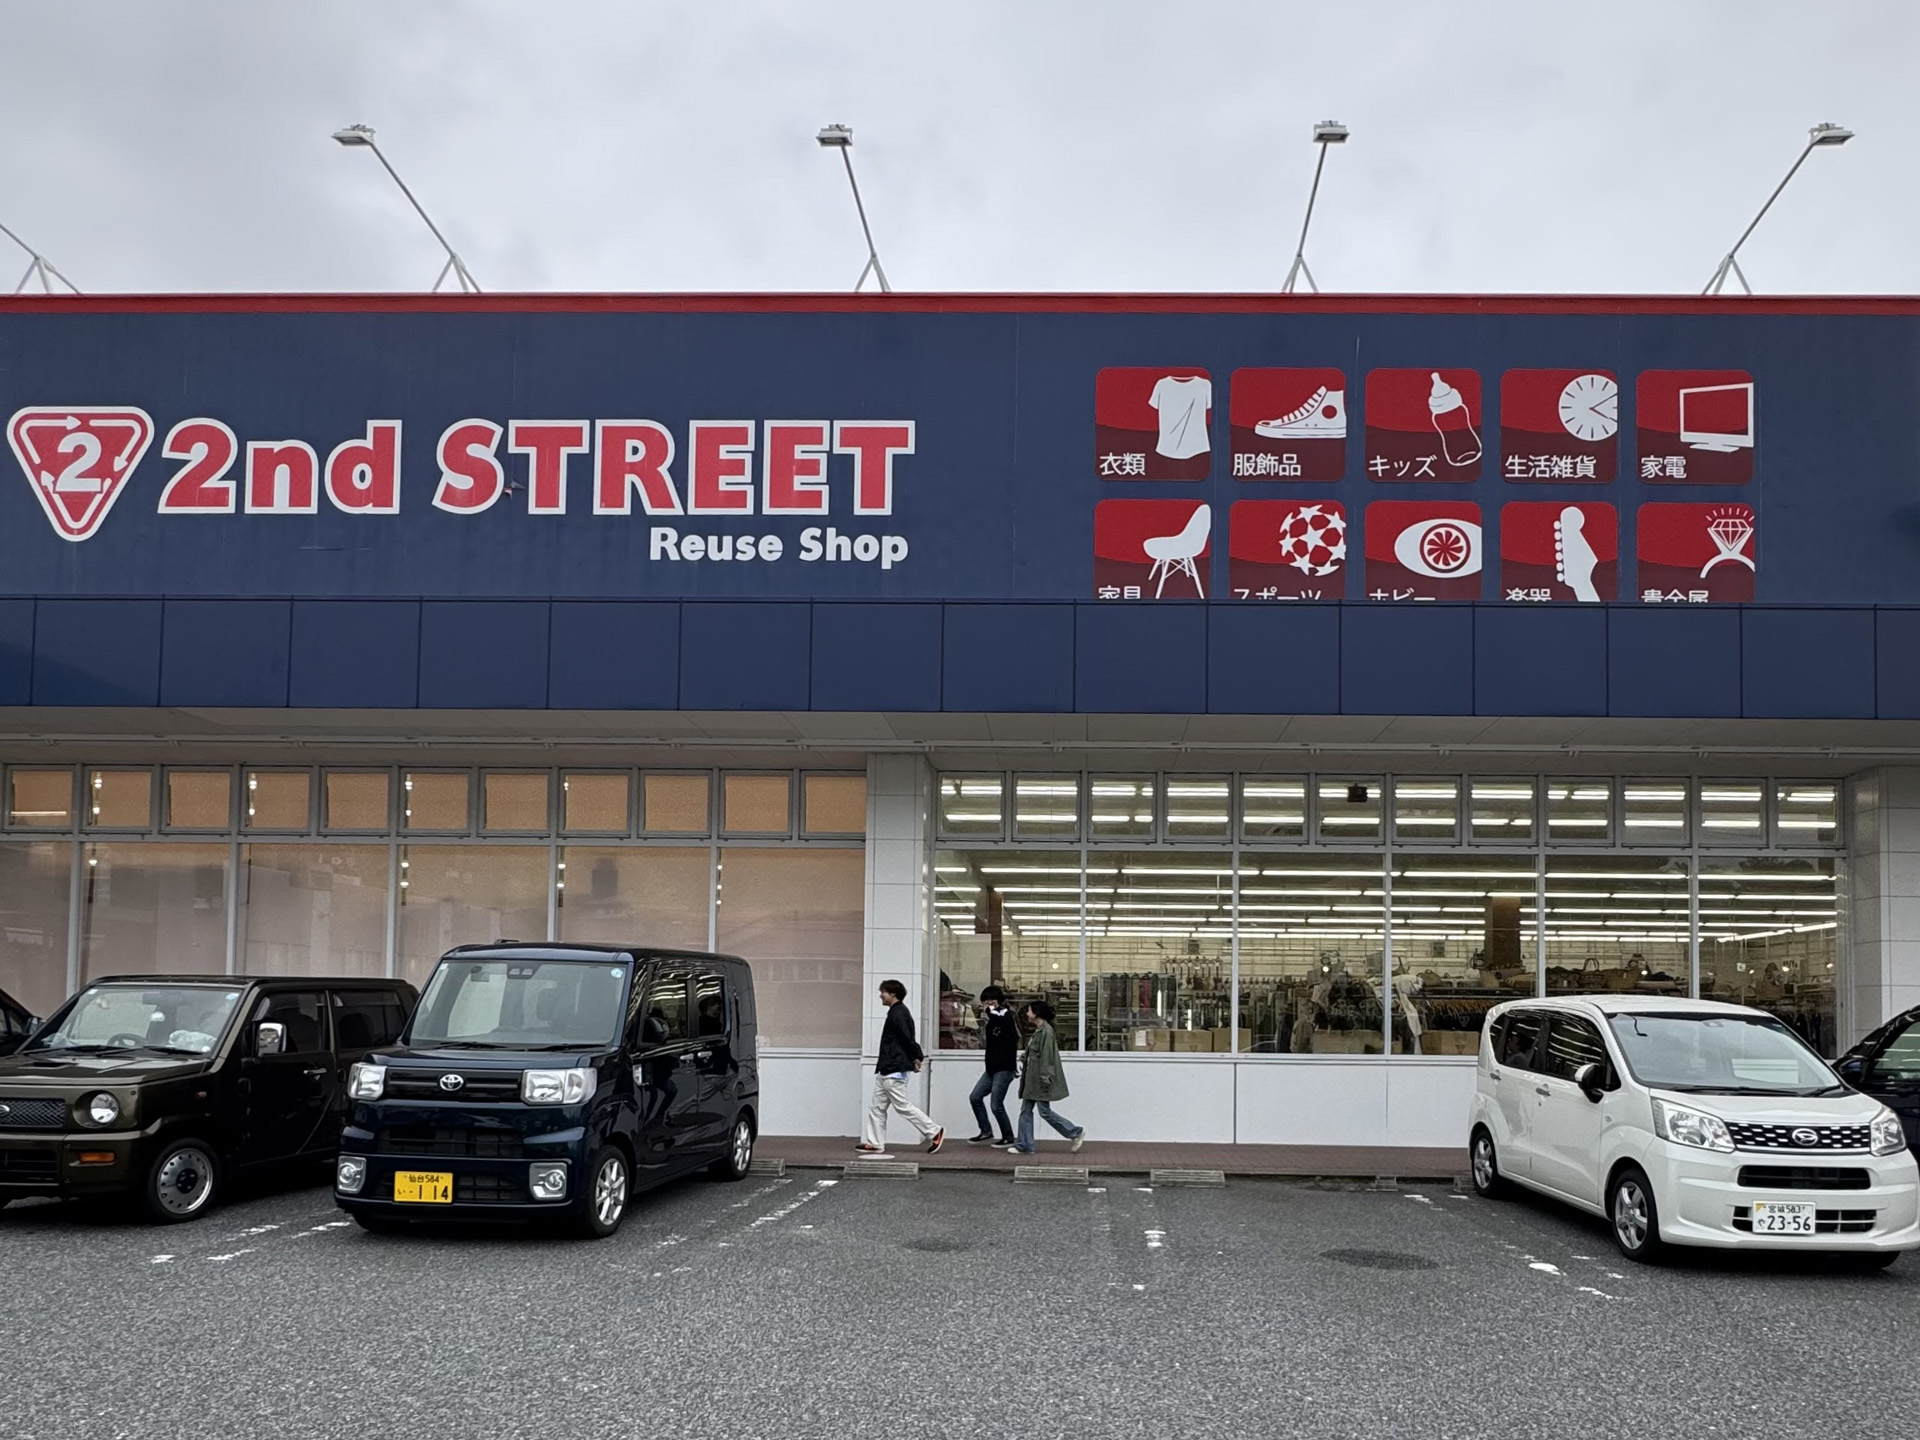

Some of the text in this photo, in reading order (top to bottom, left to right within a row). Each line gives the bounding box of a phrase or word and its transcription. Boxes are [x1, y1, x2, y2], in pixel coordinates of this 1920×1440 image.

[55, 431, 103, 493] 2
[157, 417, 916, 516] 2nd STREET
[1100, 453, 1146, 476] 衣類
[1233, 453, 1301, 477] 服飾品
[1368, 455, 1437, 477] キッズ
[1506, 455, 1597, 479] 生活雑貨
[1642, 455, 1687, 479] 家電
[649, 527, 909, 570] Reuse Shop
[1767, 1215, 1811, 1230] 23-56
